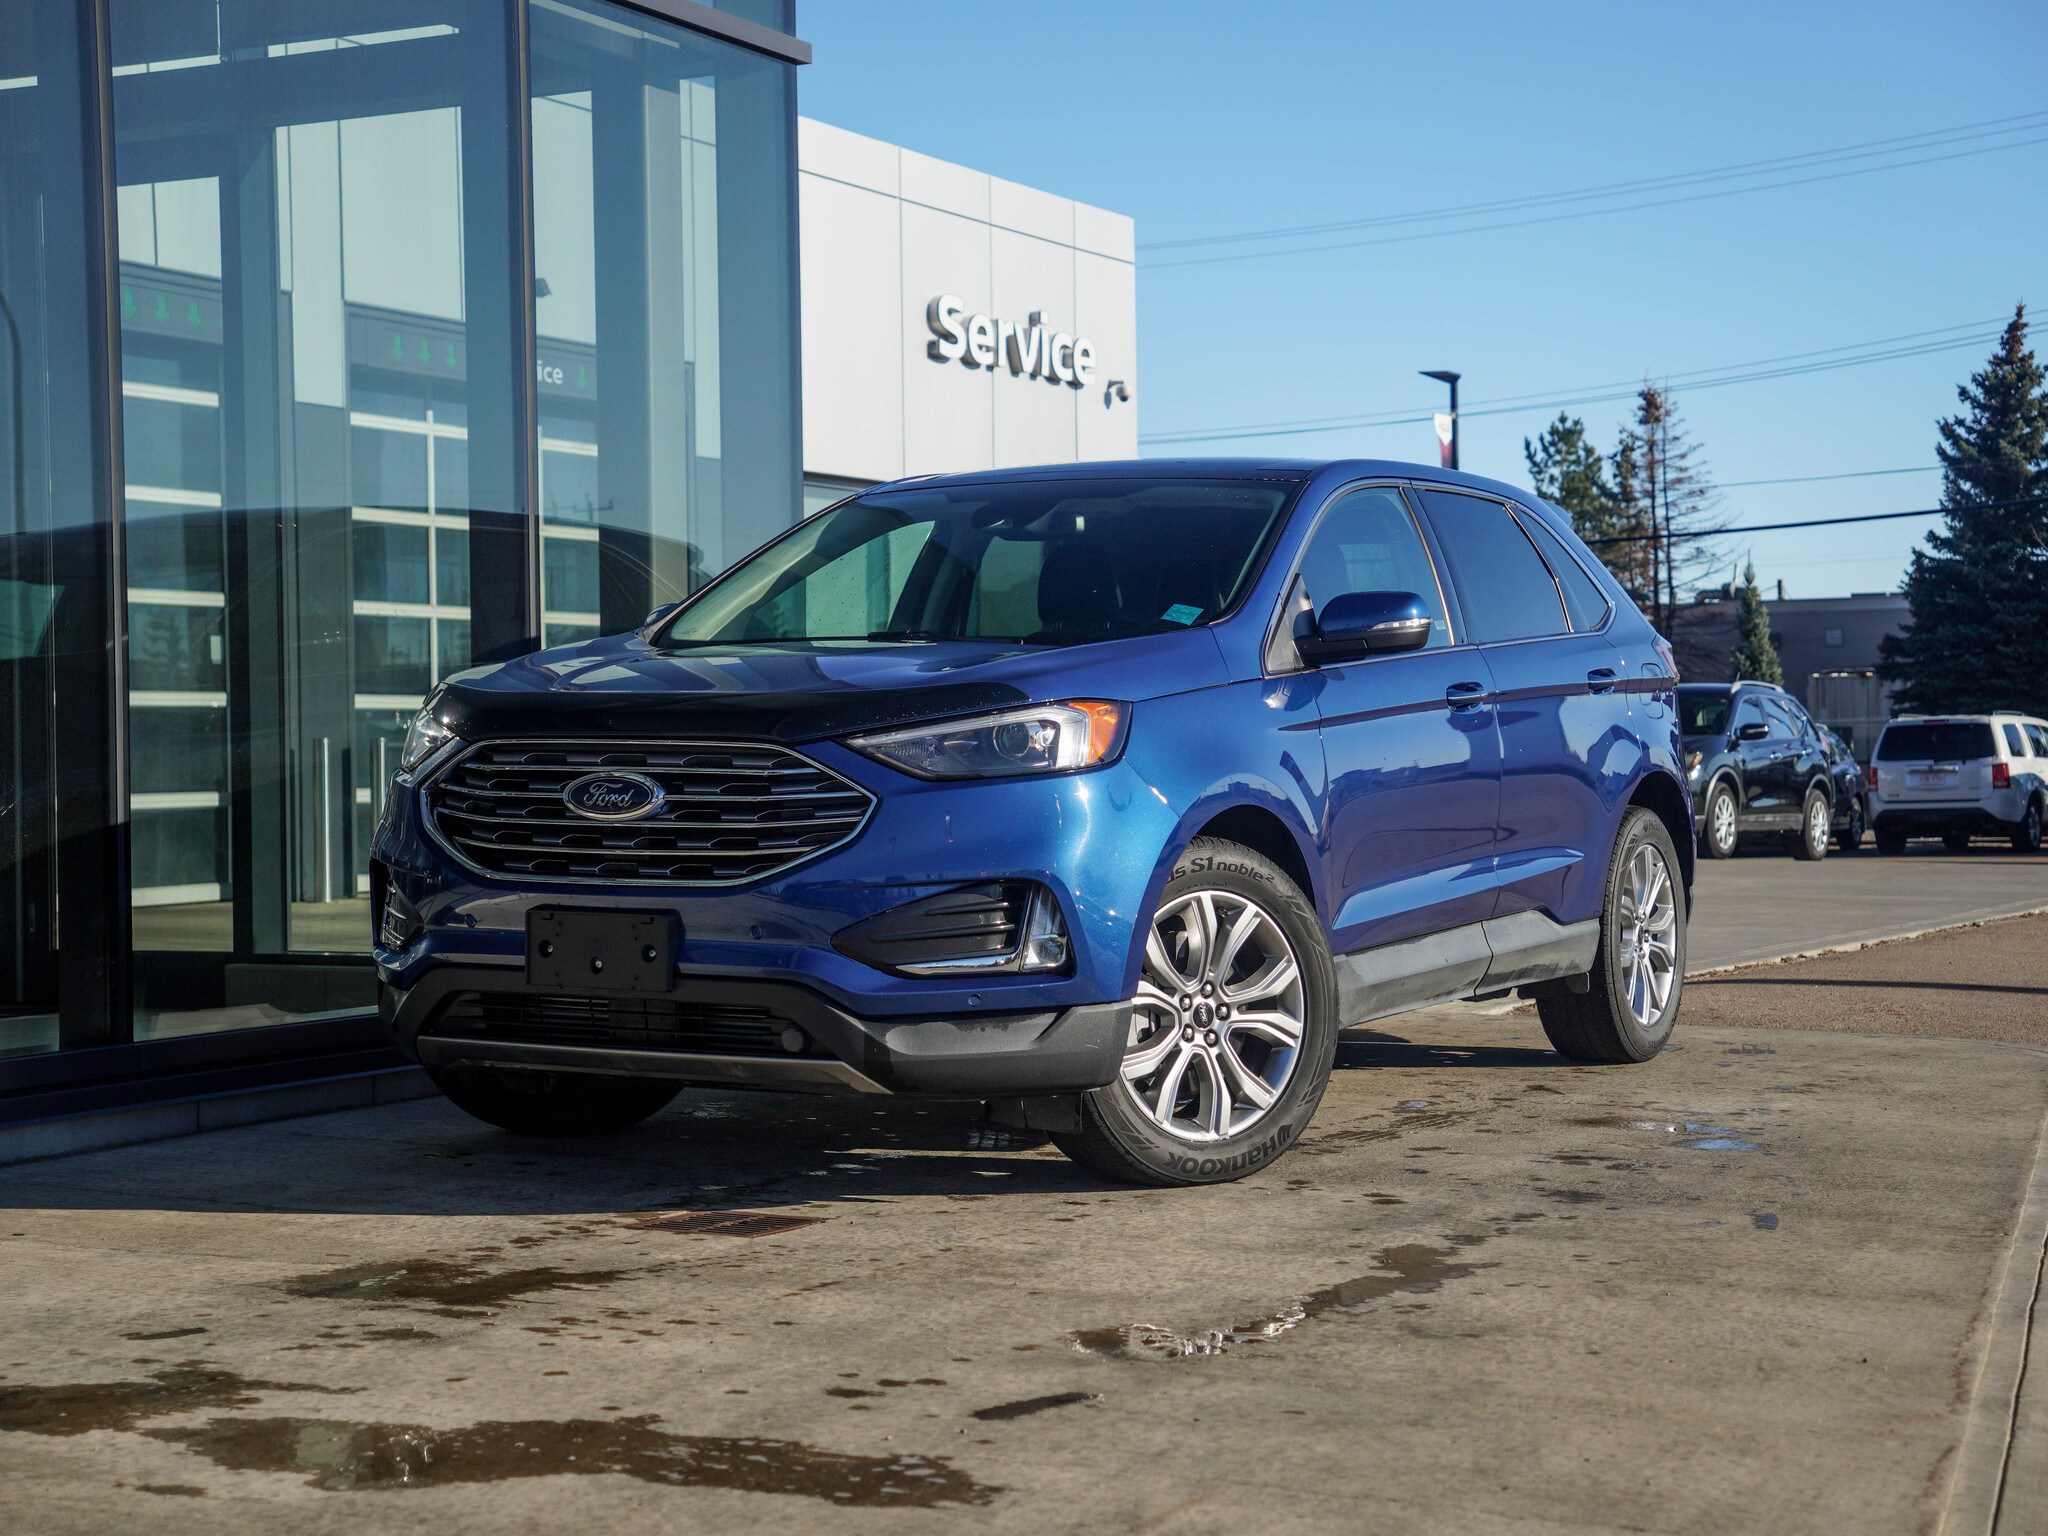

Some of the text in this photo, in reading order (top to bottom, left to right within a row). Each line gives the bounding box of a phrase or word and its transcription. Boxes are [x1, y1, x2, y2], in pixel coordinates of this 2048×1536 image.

[927, 293, 1097, 390] Service
[583, 781, 635, 809] Ford
[1190, 856, 1214, 874] S1
[1162, 1133, 1277, 1176] Hankook
